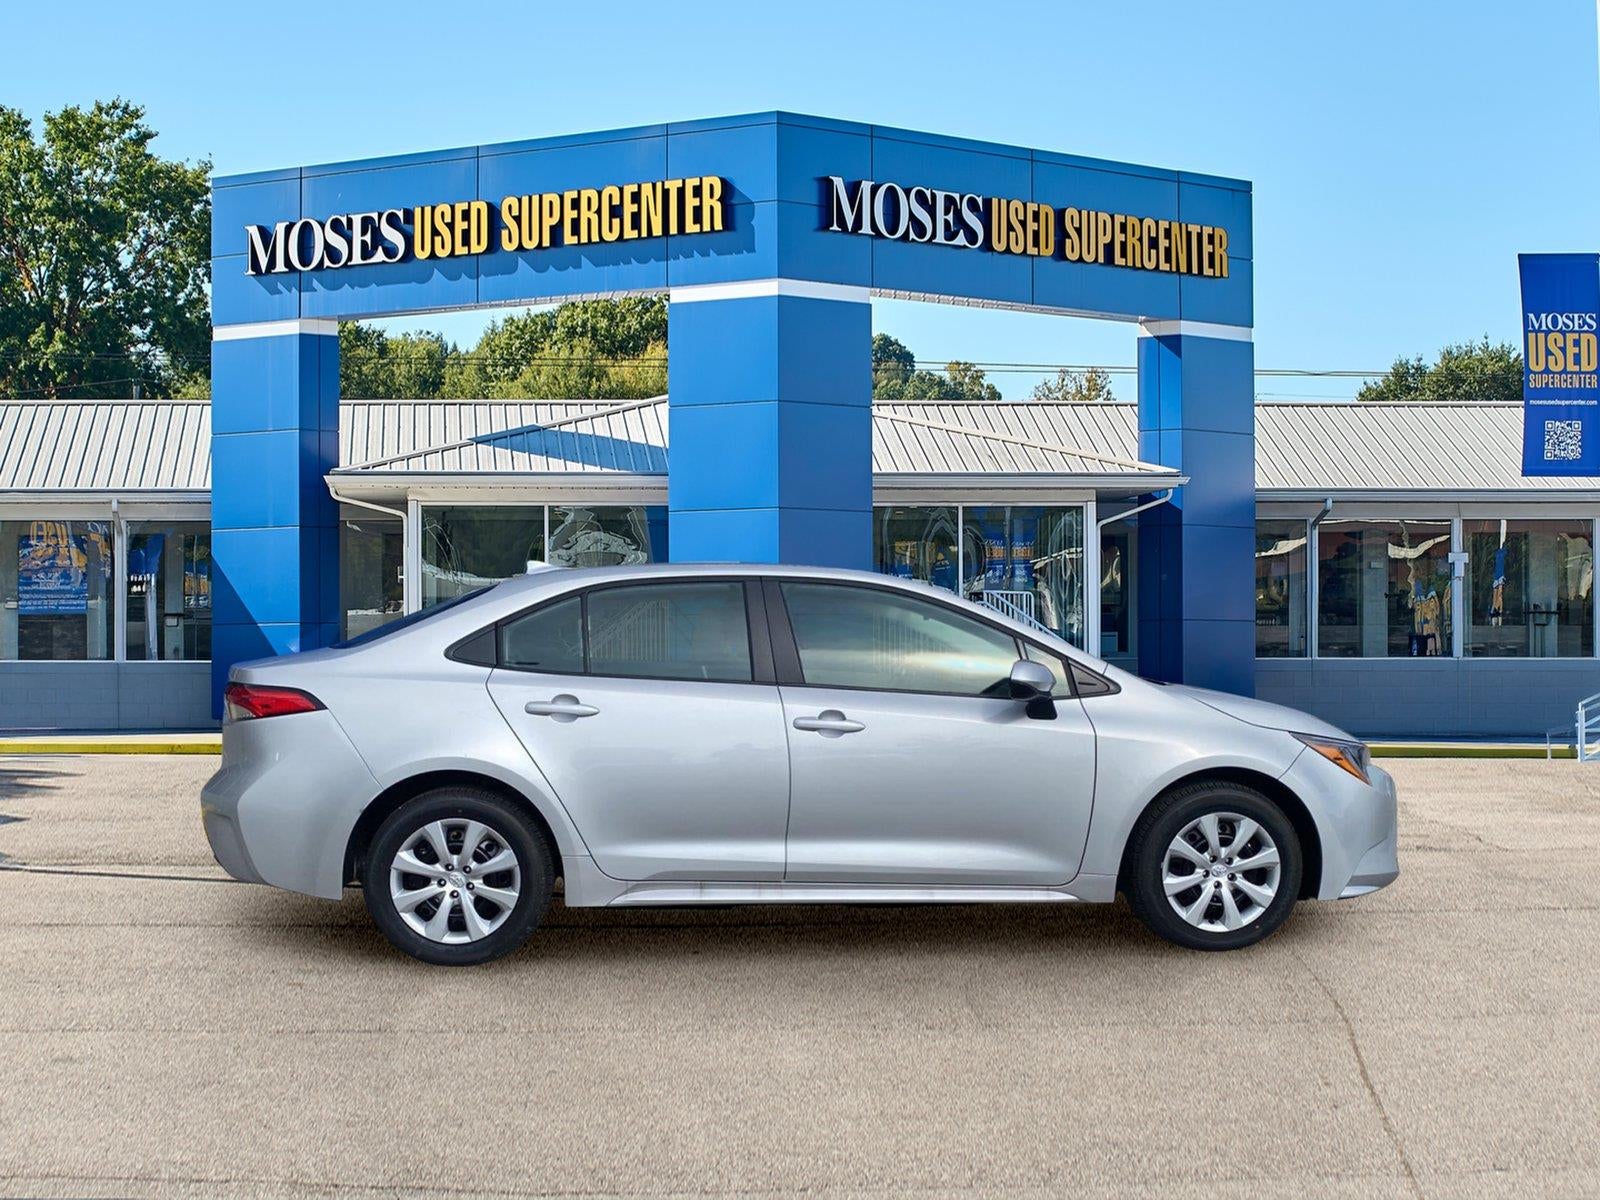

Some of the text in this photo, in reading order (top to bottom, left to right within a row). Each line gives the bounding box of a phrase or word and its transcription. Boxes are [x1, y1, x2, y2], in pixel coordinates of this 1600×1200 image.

[244, 175, 724, 276] MOSES USED SUPERCENTER
[828, 176, 1230, 278] MOSES USED SUPERCENTER
[1528, 313, 1597, 331] MOSES
[1528, 332, 1598, 372] USED
[1529, 373, 1598, 389] SUPERCENTER
